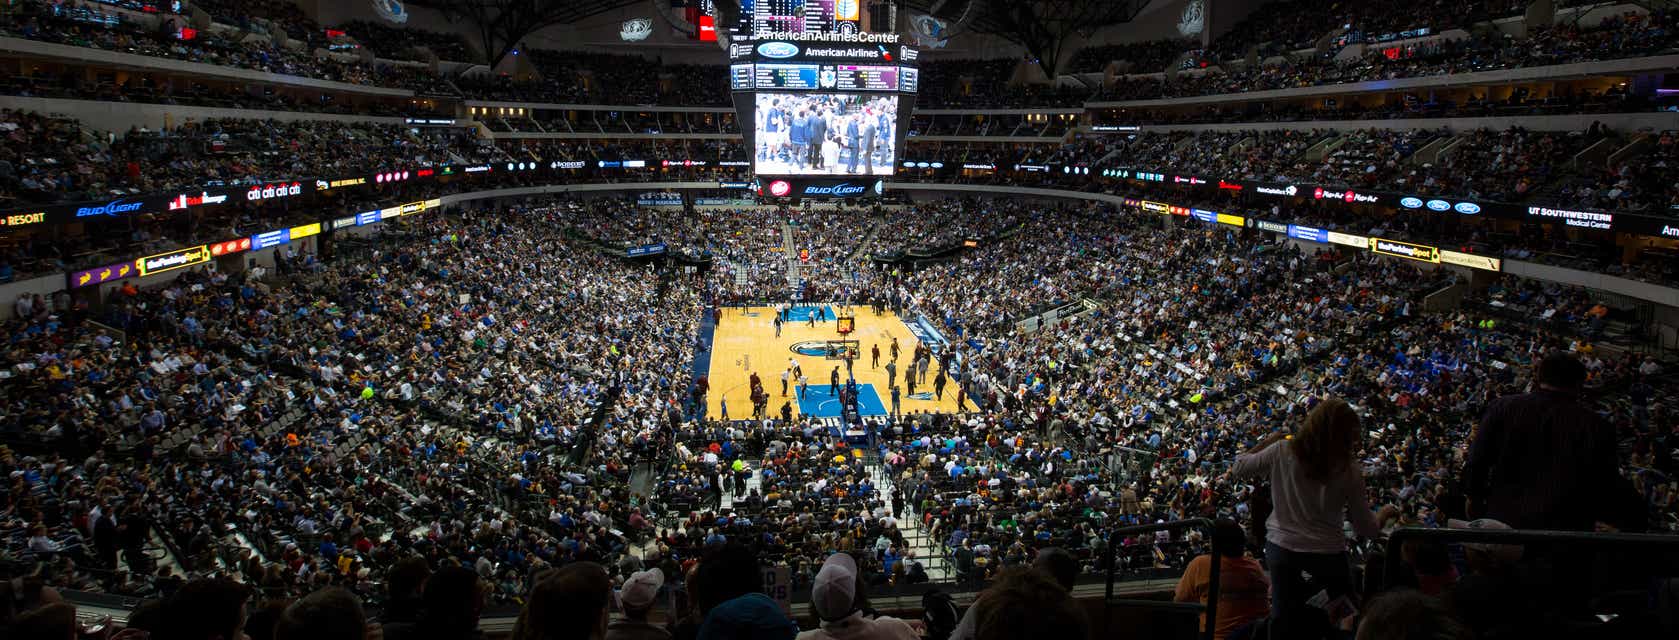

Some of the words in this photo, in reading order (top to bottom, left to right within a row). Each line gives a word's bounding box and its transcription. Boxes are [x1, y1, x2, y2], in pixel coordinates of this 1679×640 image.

[805, 47, 846, 57] American
[846, 48, 879, 58] Airlines
[804, 186, 833, 194] BUD
[835, 185, 865, 194] LIGHT
[76, 206, 106, 217] BUD
[109, 201, 143, 214] LIGHT
[1528, 206, 1541, 215] UT
[1541, 208, 1612, 222] SOUTHWESTERN
[7, 212, 46, 226] RESORT
[1566, 218, 1589, 228] Medical
[1590, 220, 1611, 229] Center
